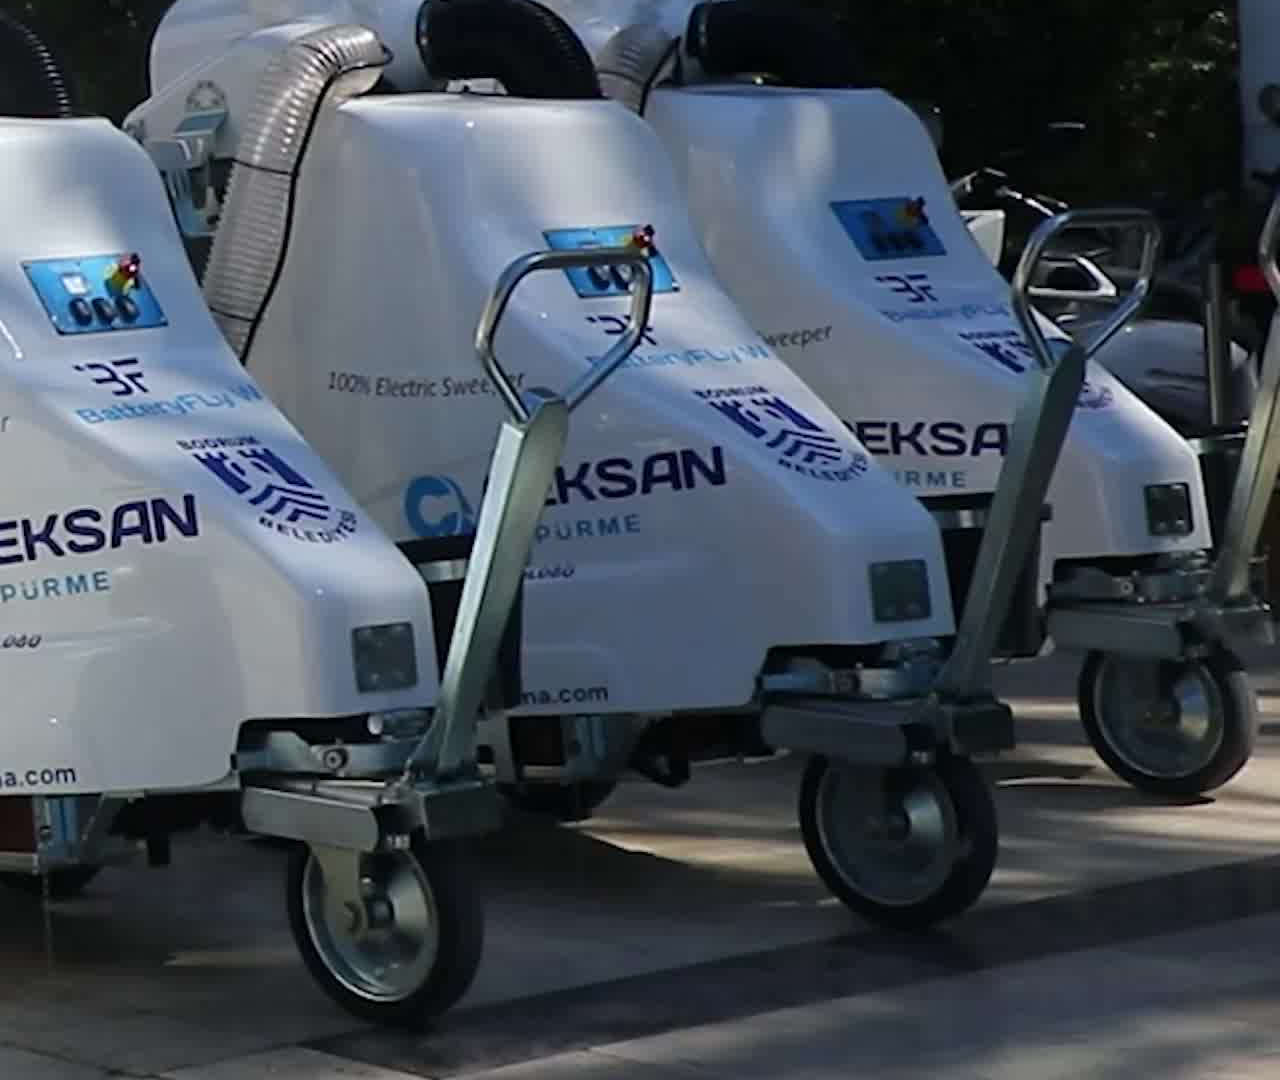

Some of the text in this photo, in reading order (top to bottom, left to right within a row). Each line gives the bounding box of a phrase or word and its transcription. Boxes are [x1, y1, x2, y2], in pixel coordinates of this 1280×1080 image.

[761, 326, 832, 348] weeper
[375, 375, 437, 398] Electric
[442, 372, 525, 398] Sweer
[842, 419, 1009, 457] EKSA
[544, 446, 727, 506] KSAN
[535, 514, 640, 544] PÜRME
